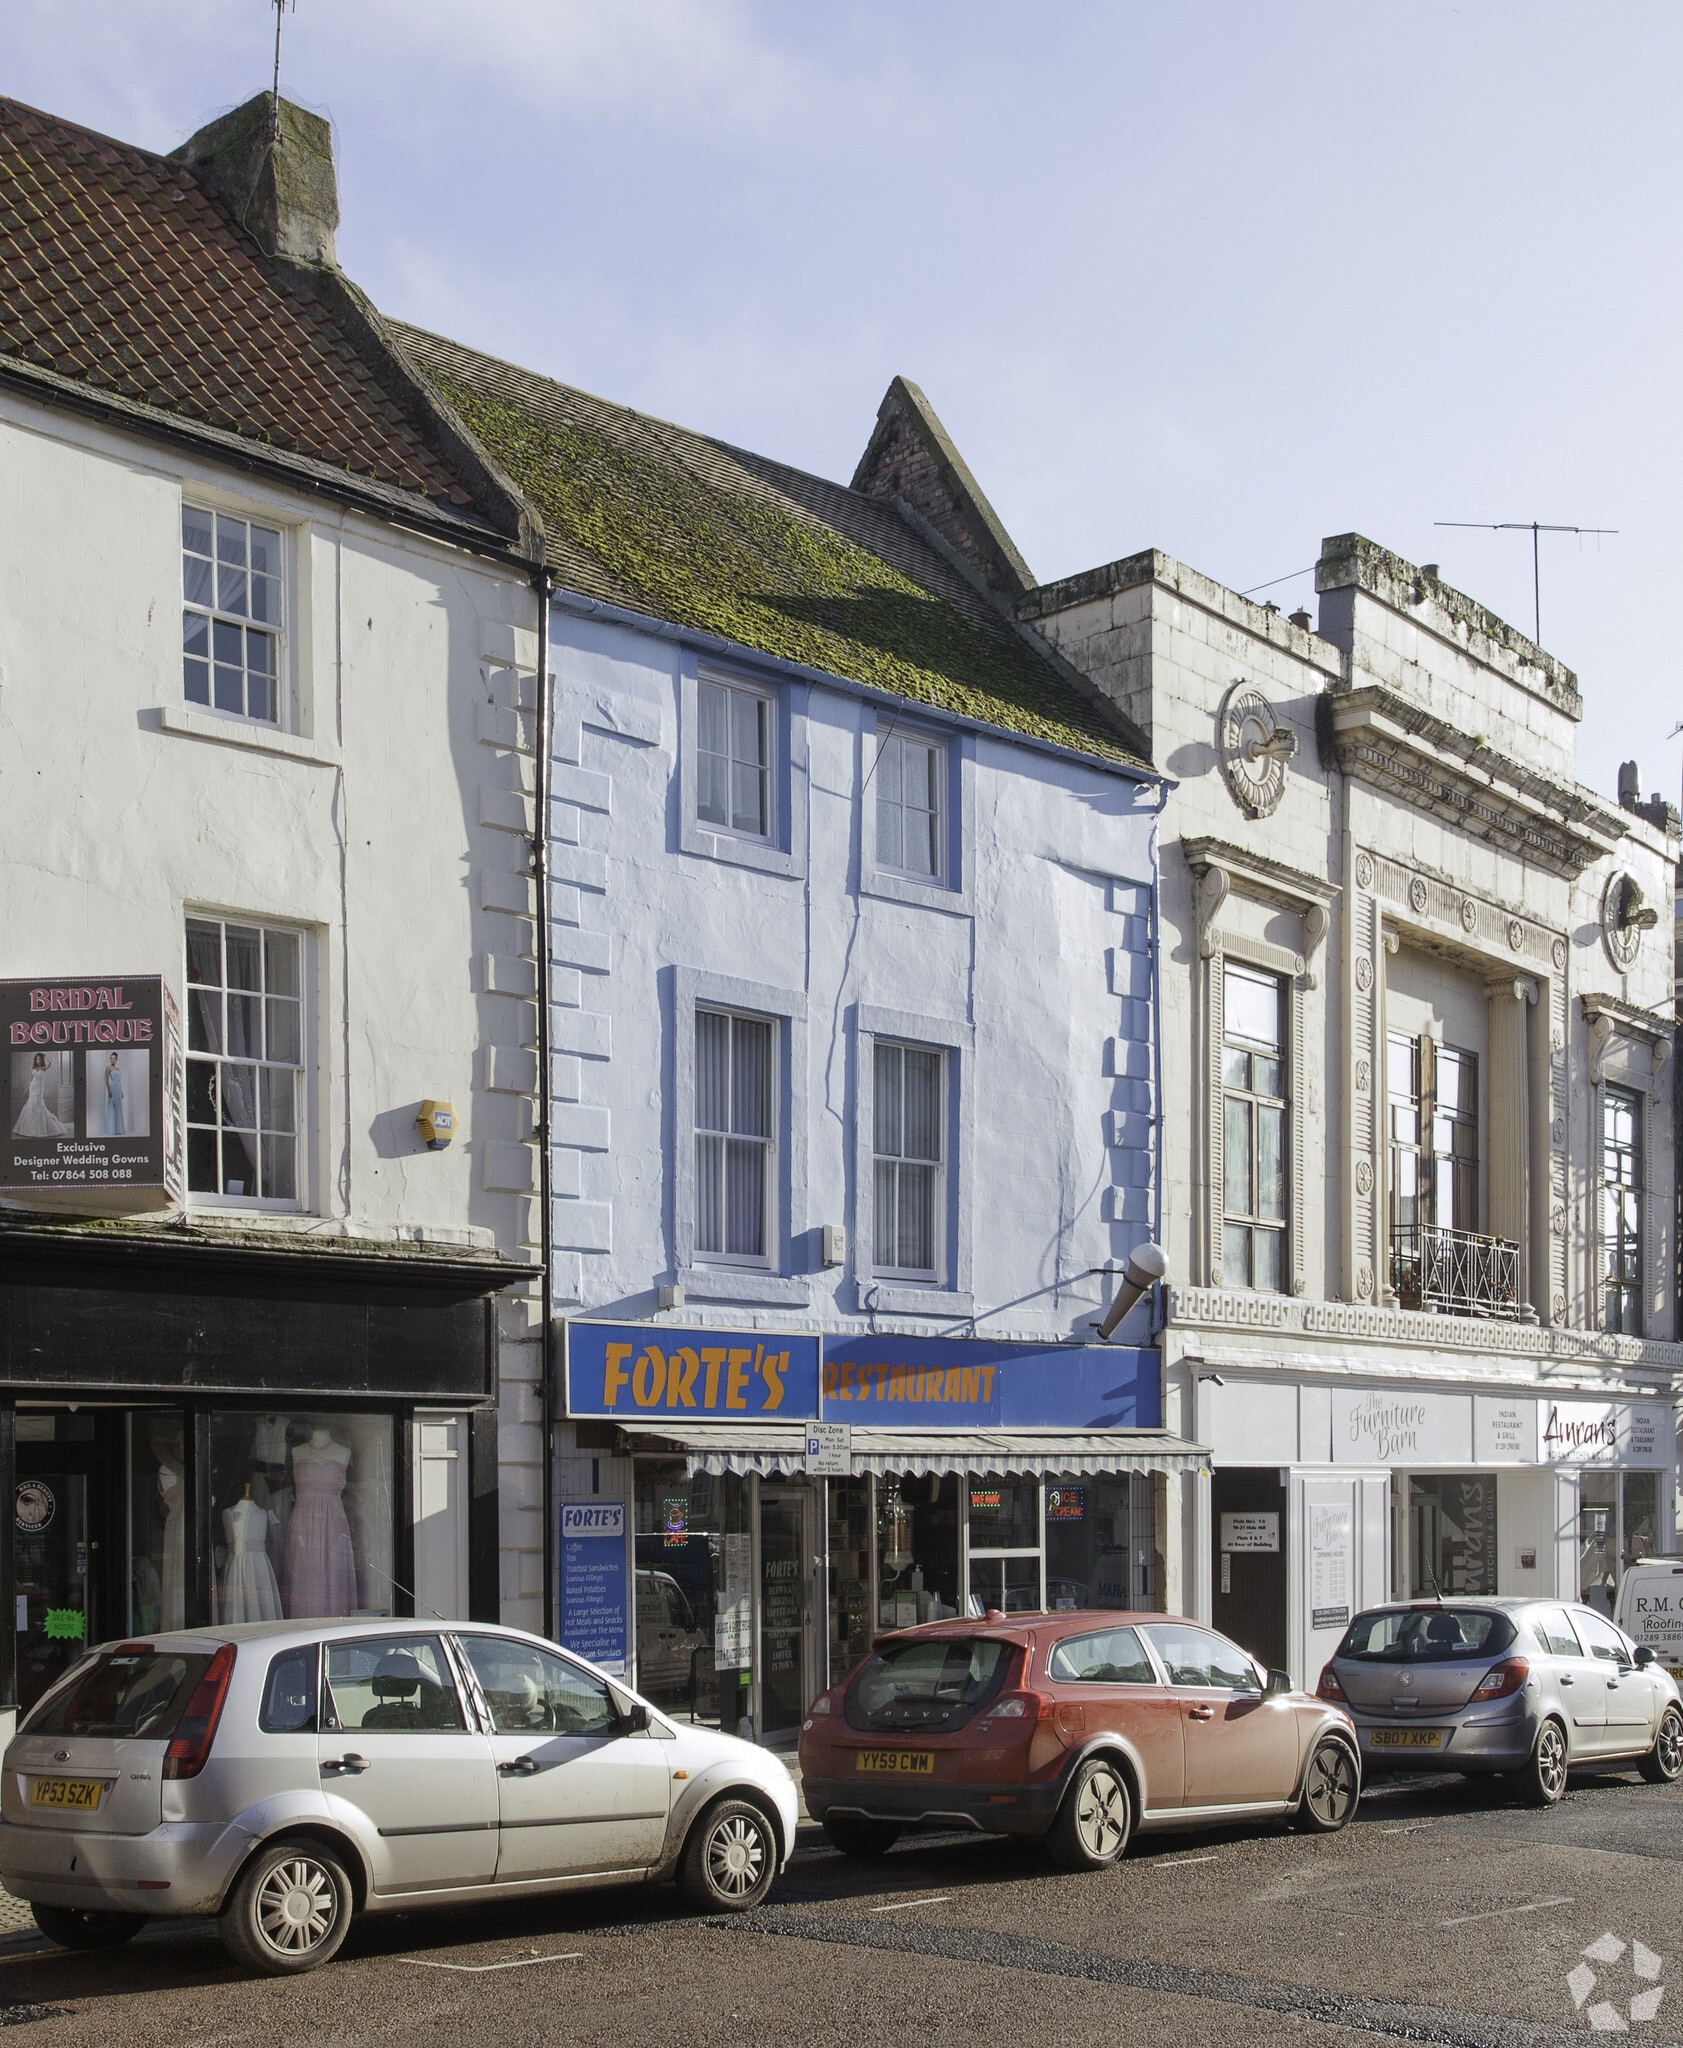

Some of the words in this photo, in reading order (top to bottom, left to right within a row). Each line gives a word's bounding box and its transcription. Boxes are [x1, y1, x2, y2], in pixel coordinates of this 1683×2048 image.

[29, 987, 133, 1011] BRIDAL
[9, 1018, 153, 1044] BOUTIQUE
[57, 1142, 106, 1152] Exclusive
[14, 1156, 60, 1167] Designer
[63, 1155, 109, 1166] Wedding
[112, 1155, 149, 1164] Gowns
[31, 1171, 49, 1180] Tel:
[52, 1170, 86, 1180] 07864
[89, 1170, 109, 1179] 508
[112, 1169, 132, 1179] 088
[602, 1343, 789, 1410] FORTE'S
[822, 1361, 996, 1404] RESTAURANT
[1366, 1392, 1383, 1412] The
[1350, 1402, 1425, 1442] Furniture
[1542, 1406, 1616, 1448] Amran's
[813, 1426, 826, 1434] Disc
[828, 1426, 843, 1434] Zone
[1374, 1426, 1417, 1460] Barn
[971, 1494, 984, 1504] TAKE
[985, 1494, 1000, 1504] AWAY
[1061, 1492, 1077, 1503] ICE
[1055, 1506, 1081, 1517] CREAM
[565, 1508, 621, 1527] FORTE'S
[1314, 1512, 1347, 1538] Furniture
[664, 1530, 687, 1544] CAFE
[566, 1542, 583, 1552] Coffee
[566, 1554, 576, 1562] Tea
[566, 1564, 587, 1573] Toasted
[588, 1563, 619, 1572] Sandwiches
[765, 1560, 799, 1578] FORTE'S
[566, 1574, 585, 1584] (various
[586, 1573, 603, 1583] Fillings)
[566, 1586, 582, 1594] Baked
[583, 1585, 606, 1593] Potatoes
[566, 1596, 585, 1605] (various
[586, 1596, 603, 1604] Fillings)
[1636, 1597, 1673, 1612] R.M.
[573, 1608, 589, 1617] Large
[590, 1606, 613, 1615] Selection
[614, 1605, 620, 1616] of
[565, 1619, 575, 1627] Hot
[576, 1617, 592, 1626] Meals
[605, 1616, 623, 1624] Snacks
[564, 1628, 589, 1636] Available
[570, 1640, 580, 1648] We
[581, 1637, 609, 1649] Specialise
[611, 1637, 617, 1645] in
[1634, 1634, 1659, 1642] 01289
[575, 1650, 596, 1659] Cream
[597, 1648, 622, 1657] Sundaes
[772, 1650, 792, 1660] COFFEE
[778, 1660, 794, 1670] TOWN
[867, 1710, 950, 1718] VOLVO
[1375, 1732, 1407, 1745] SB07
[1411, 1732, 1436, 1745] XKP
[863, 1753, 897, 1769] YY59
[900, 1754, 928, 1771] CWM
[36, 1781, 65, 1802] YP53
[67, 1784, 97, 1806] SZK
